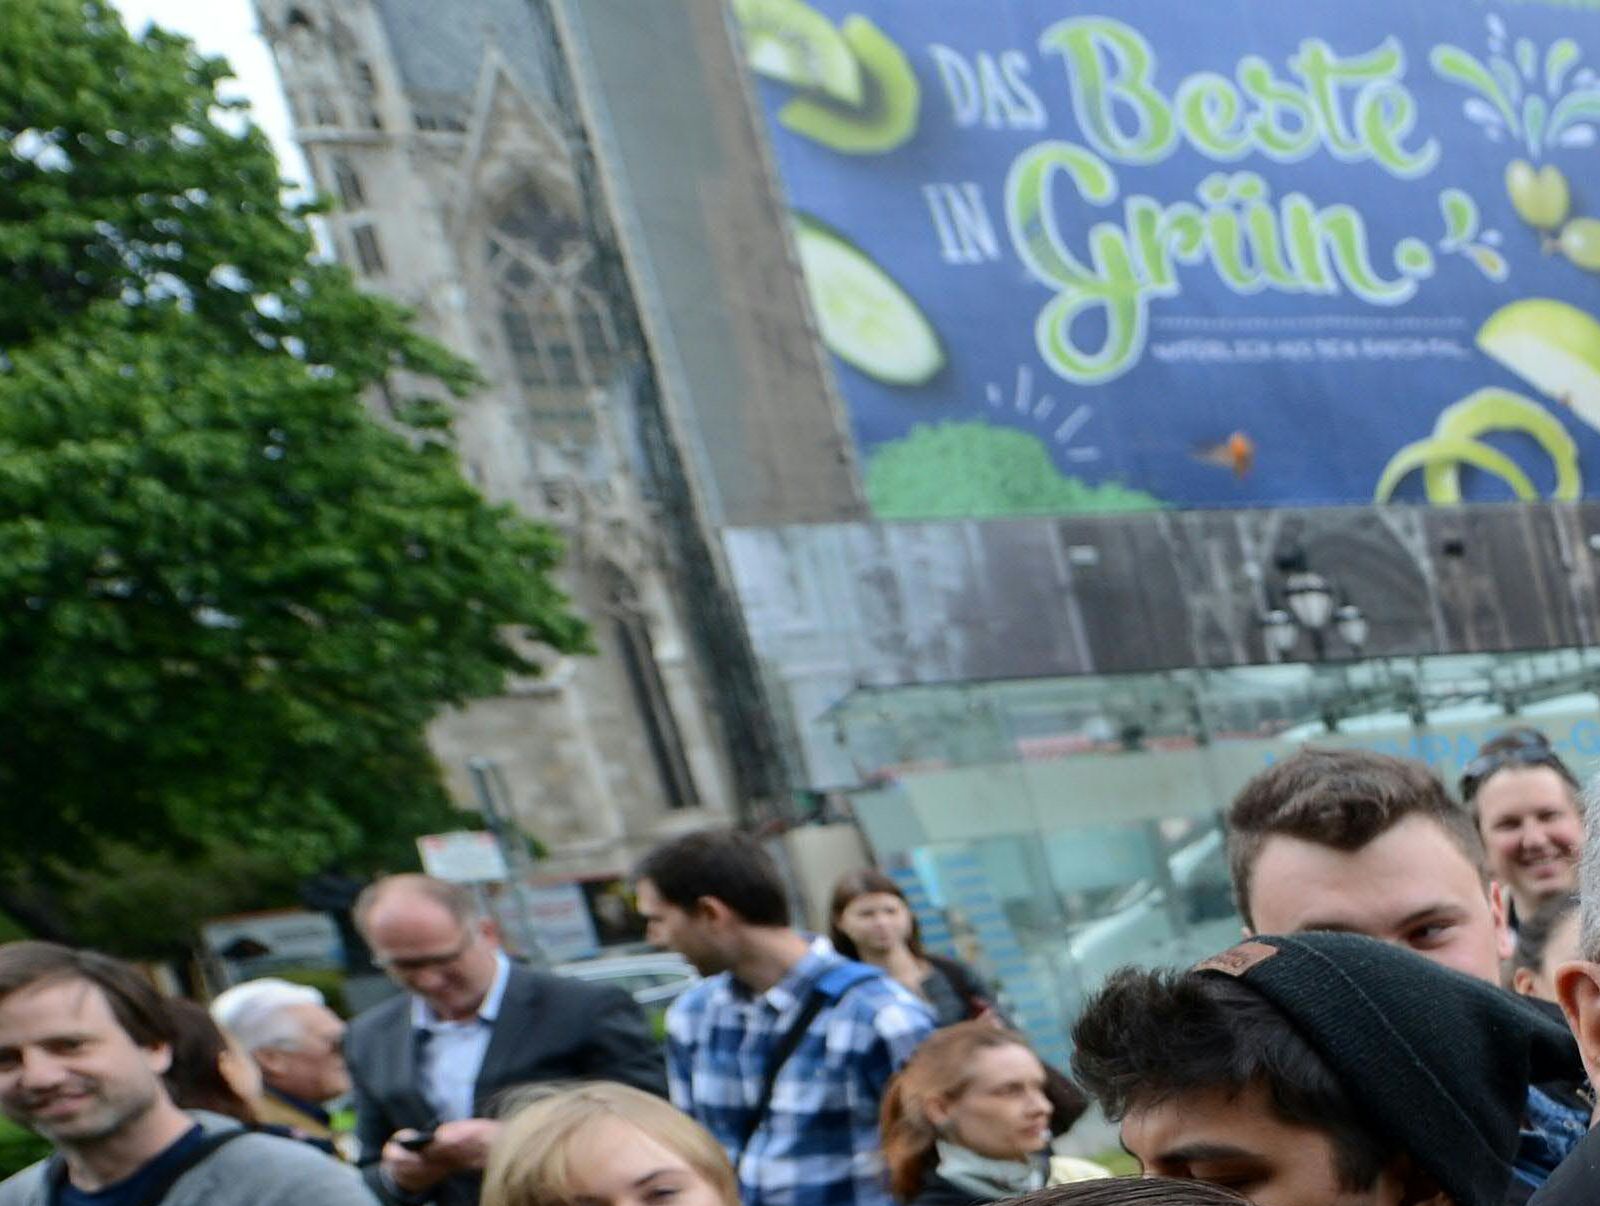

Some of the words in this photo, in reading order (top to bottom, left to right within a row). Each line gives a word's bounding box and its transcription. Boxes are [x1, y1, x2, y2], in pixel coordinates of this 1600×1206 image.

[928, 44, 1047, 131] DAS
[1038, 15, 1441, 180] Beste
[922, 181, 998, 265] IN
[1005, 140, 1436, 386] Grün.
